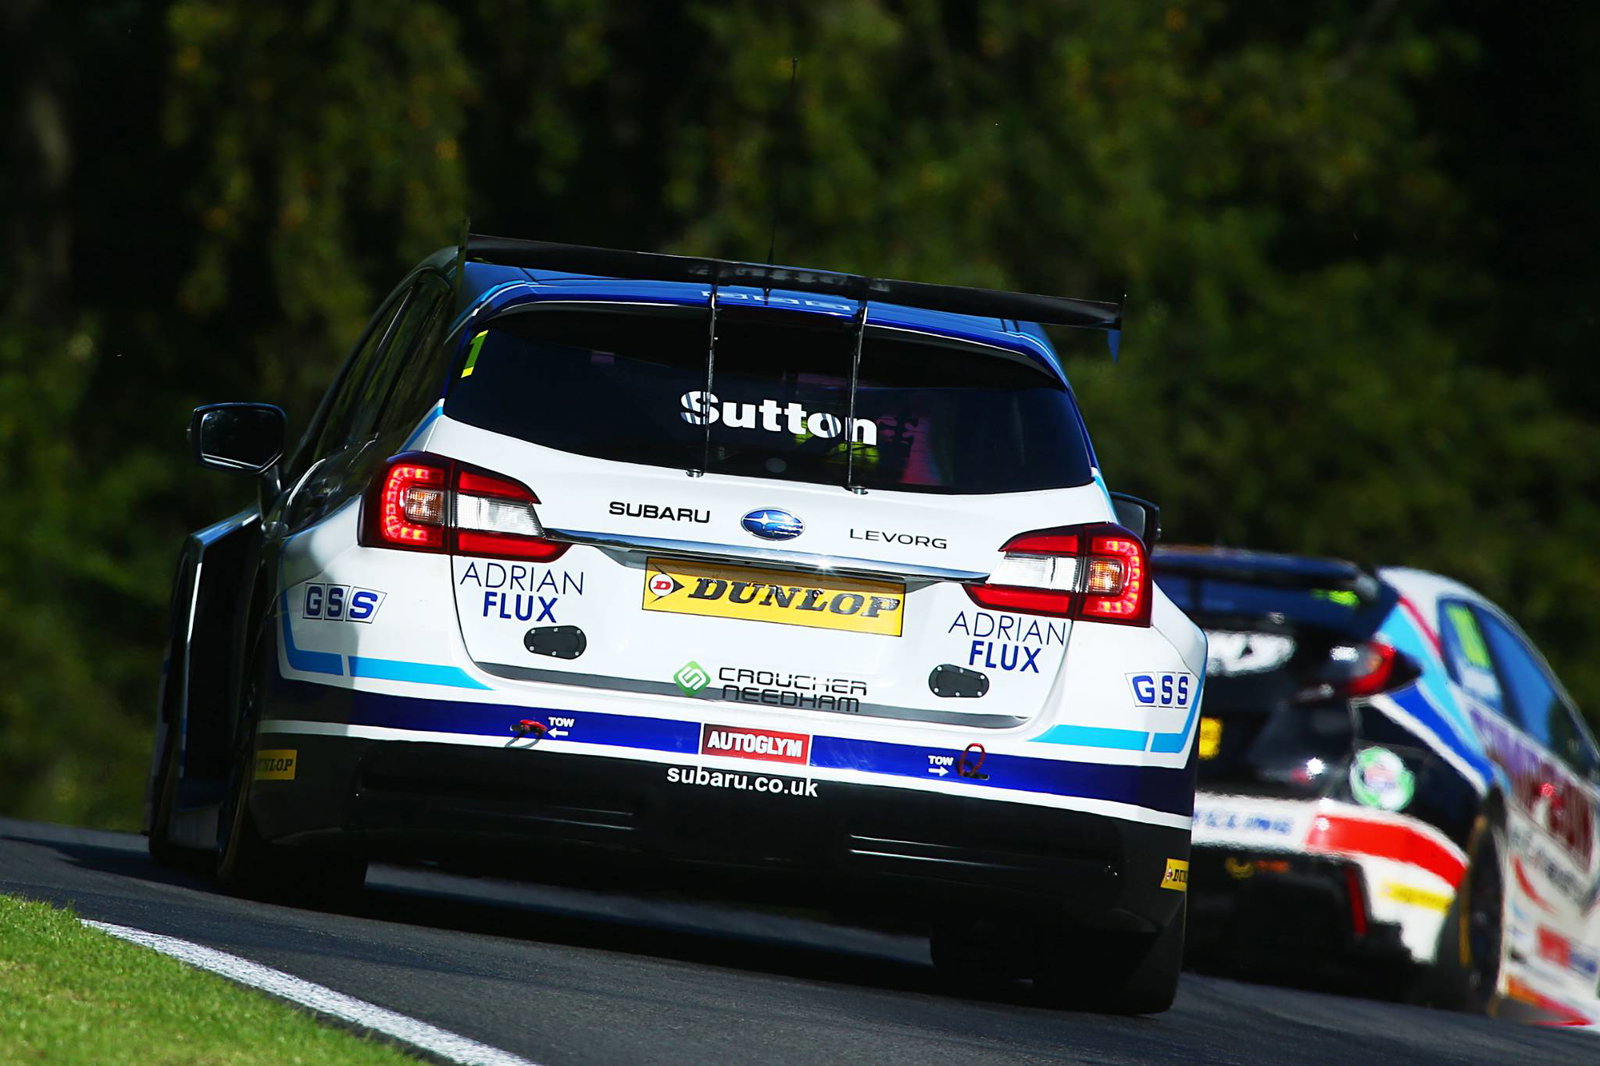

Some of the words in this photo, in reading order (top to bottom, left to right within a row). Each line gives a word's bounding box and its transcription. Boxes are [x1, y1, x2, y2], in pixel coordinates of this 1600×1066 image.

[681, 390, 877, 446] Sutton
[609, 501, 711, 524] SUBARU
[850, 528, 948, 550] LEVORG
[460, 561, 584, 596] ADRIAN
[306, 585, 379, 619] GSS
[483, 591, 558, 623] FLUX
[687, 577, 901, 618] DUNLOP
[948, 610, 1066, 646] ADRIAN
[969, 640, 1042, 673] FLUX
[718, 666, 867, 696] CROUCHER
[1132, 674, 1189, 705] GSS
[722, 685, 860, 713] NEEDHAM
[548, 716, 575, 728] TOW
[707, 730, 803, 757] AUTOGLYM
[928, 754, 954, 766] TOW
[667, 766, 818, 798] subaru.co.uk
